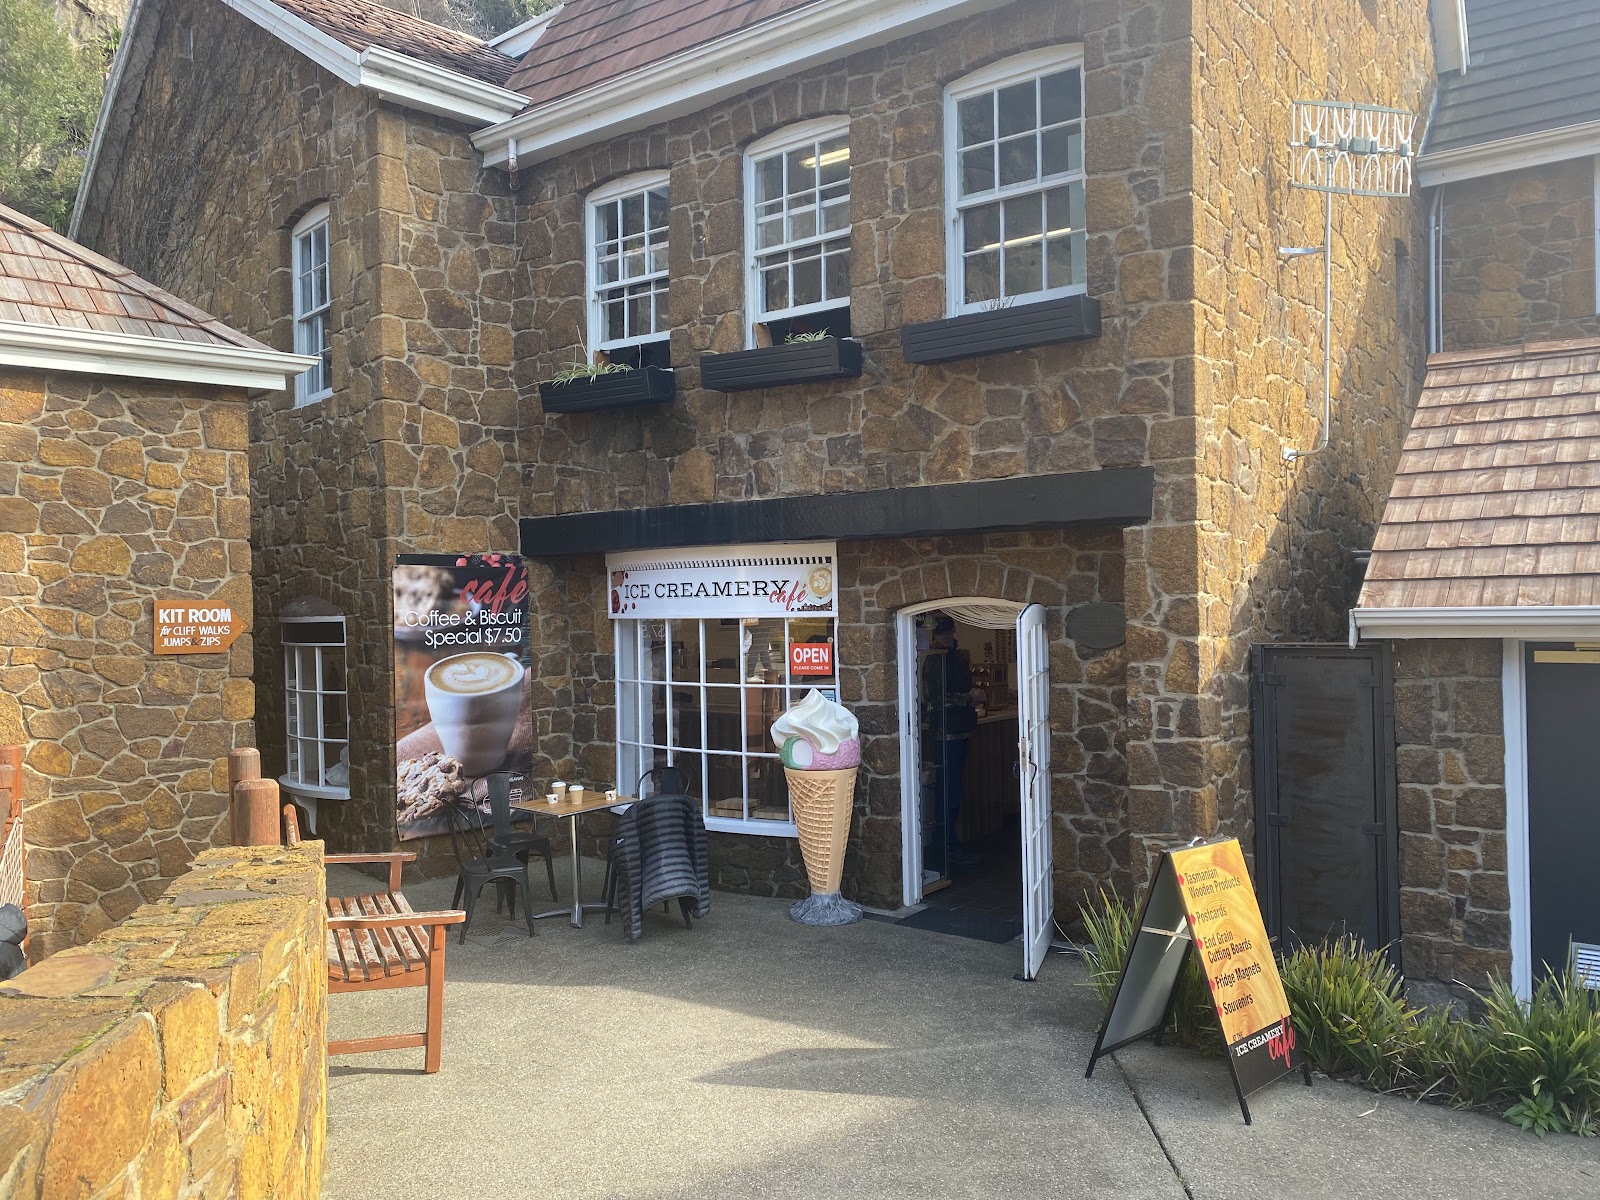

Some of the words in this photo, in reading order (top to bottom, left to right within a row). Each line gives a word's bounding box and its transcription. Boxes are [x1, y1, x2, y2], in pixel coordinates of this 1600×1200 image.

[460, 563, 529, 618] café
[624, 584, 650, 599] ICE
[654, 580, 789, 598] CREAMERY
[768, 580, 808, 611] café
[159, 608, 185, 623] KIT
[188, 608, 232, 623] ROOM
[404, 609, 460, 627] Coffee
[464, 610, 477, 626] &
[480, 608, 522, 625] Biscuit
[160, 625, 172, 637] for
[173, 626, 196, 636] CLIFF
[199, 625, 231, 635] WALKS
[425, 628, 481, 649] Special
[484, 627, 522, 646] $7.50
[161, 637, 191, 647] JUMPS
[201, 636, 220, 646] ZIPS
[793, 647, 829, 663] OPEN
[1184, 868, 1218, 885] Tasmanian
[1188, 883, 1215, 899] Wooden
[1213, 876, 1241, 893] Products
[1195, 905, 1228, 924] Postcards
[1203, 933, 1217, 949] End
[1216, 929, 1234, 945] Grain
[1207, 946, 1232, 963] Cutting
[1230, 938, 1253, 955] Boards
[1215, 972, 1236, 989] Fridge
[1235, 962, 1262, 980] Magnets
[1222, 994, 1254, 1015] Souvenirs
[1235, 1043, 1249, 1057] ICE
[1247, 1024, 1284, 1051] CREAMERY
[1268, 1014, 1296, 1069] café
